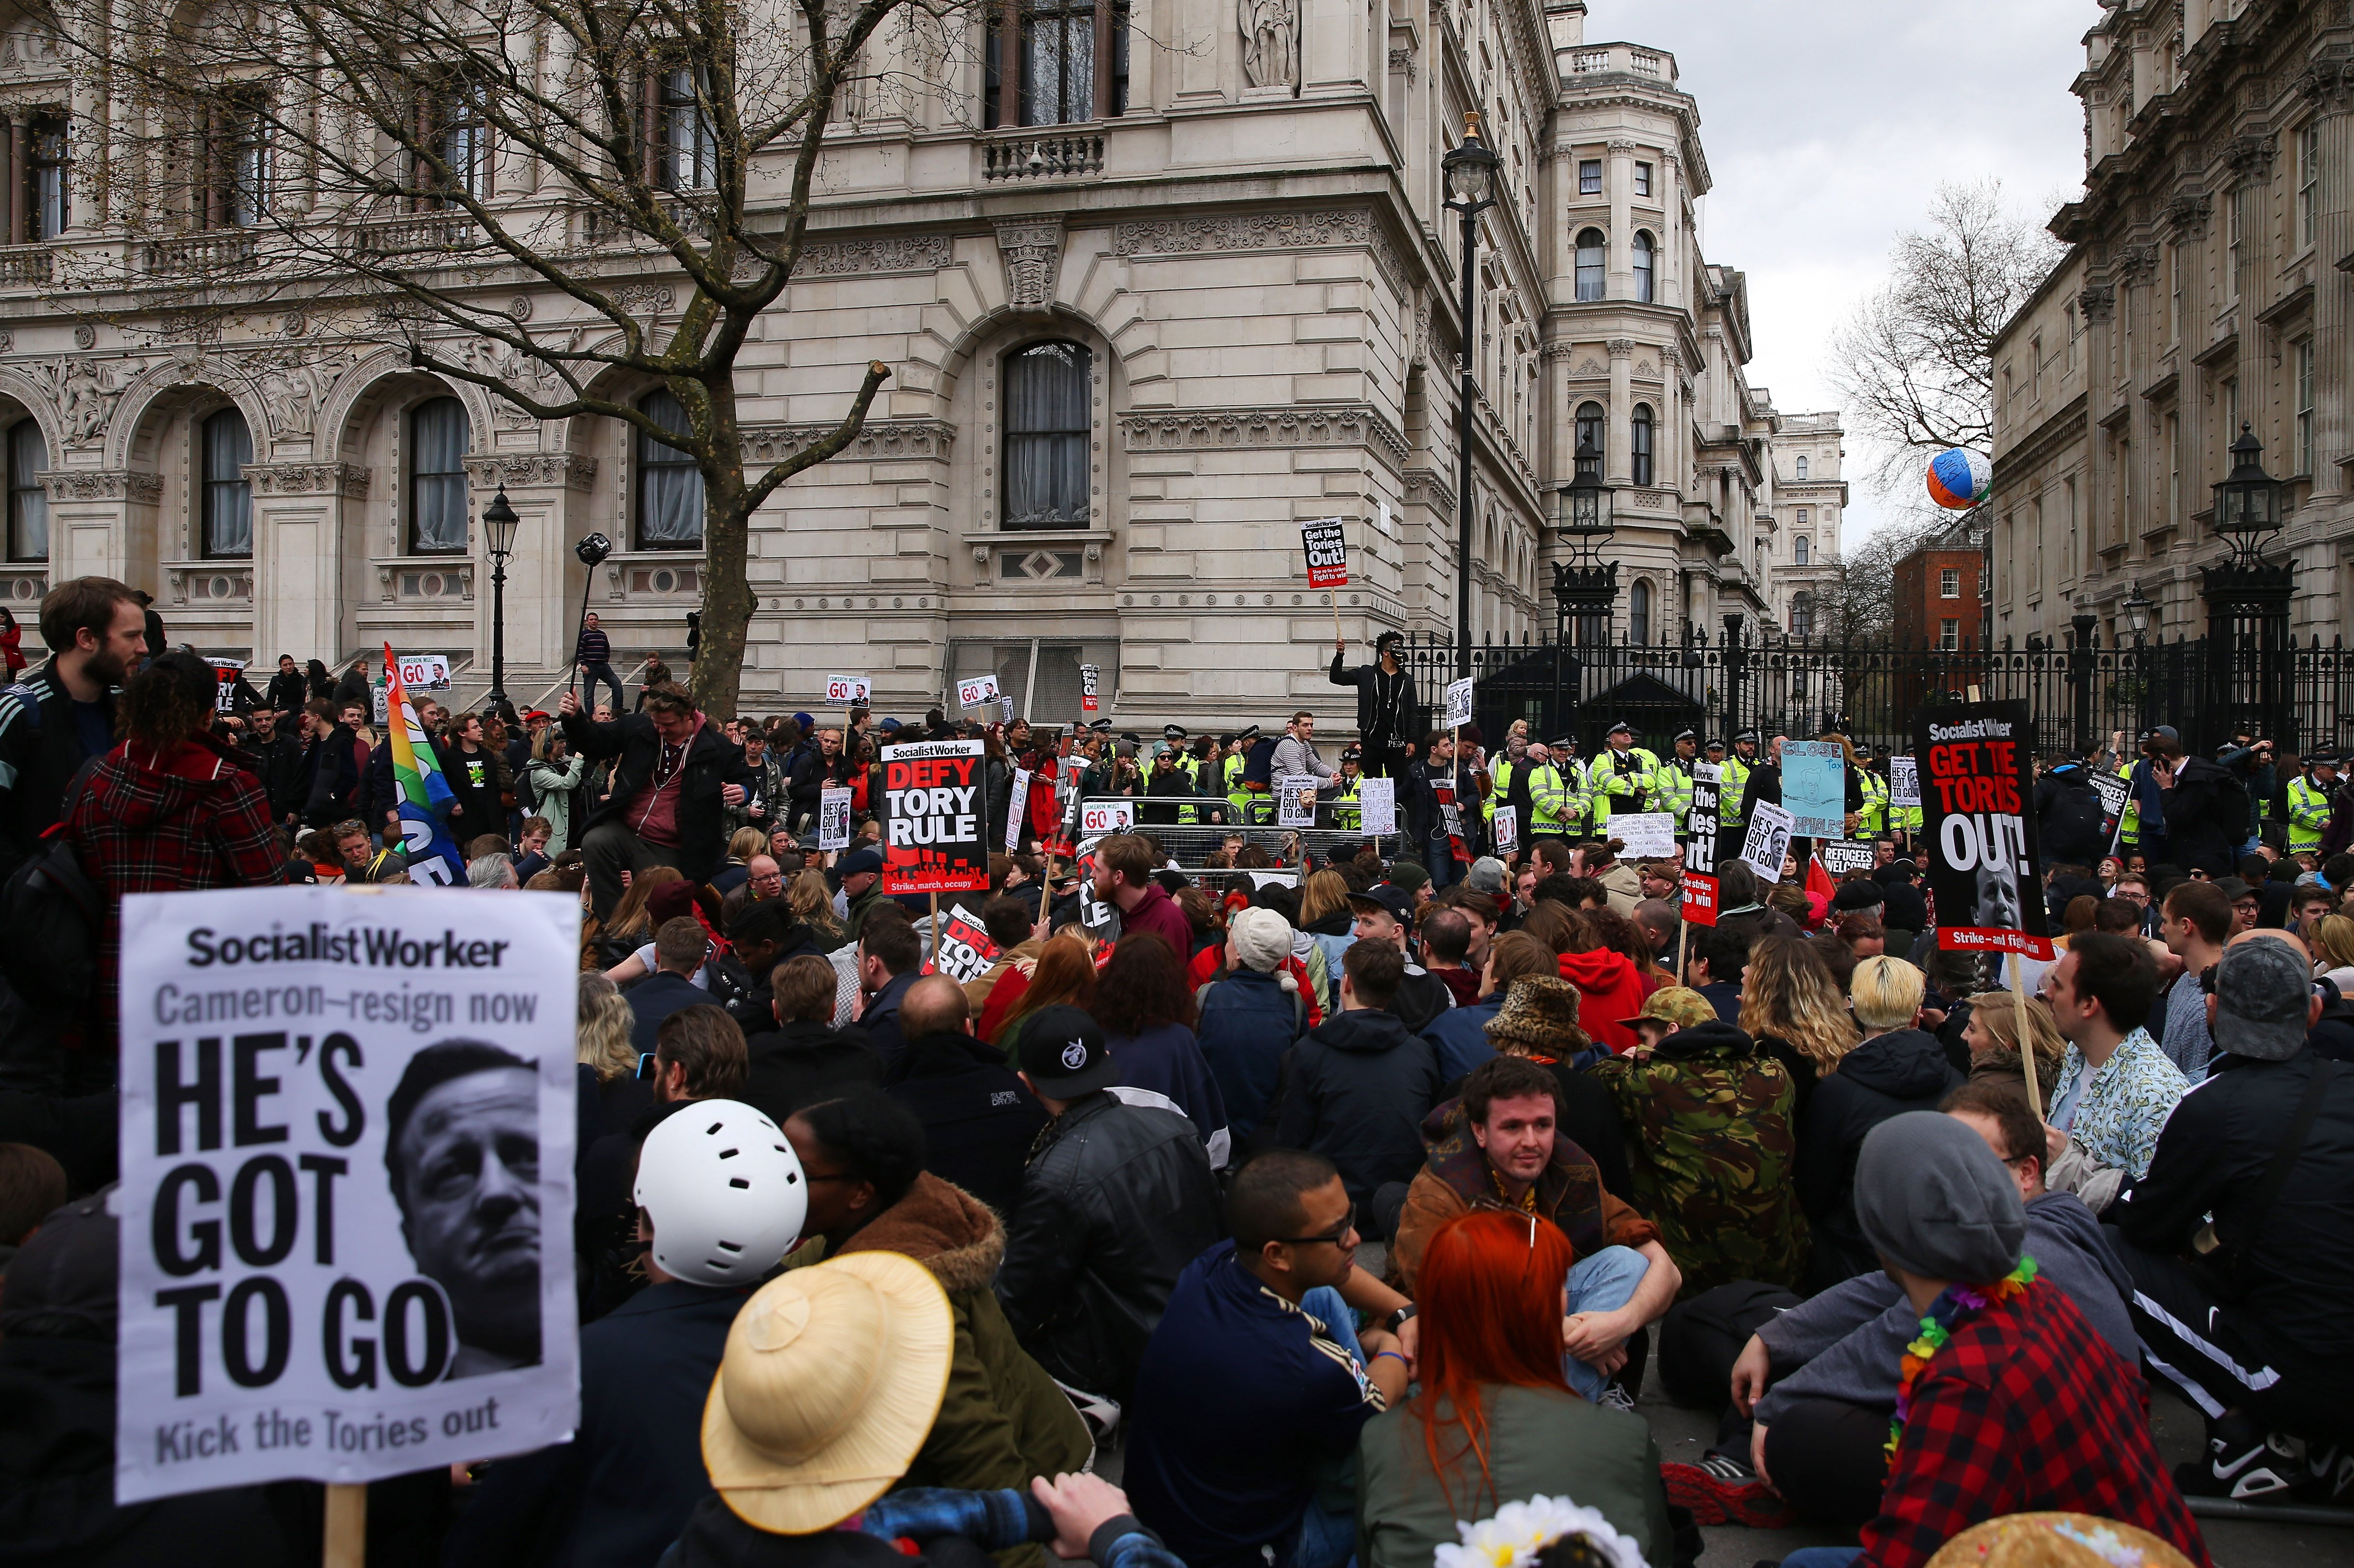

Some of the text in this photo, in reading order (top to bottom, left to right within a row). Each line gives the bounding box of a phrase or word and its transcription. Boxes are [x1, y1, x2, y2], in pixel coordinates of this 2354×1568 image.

[1306, 529, 1340, 540] Get the
[1306, 538, 1343, 551] Tories
[1309, 547, 1345, 566] Out!
[1313, 573, 1329, 582] Fight
[218, 668, 238, 682] FY
[403, 665, 424, 683] GO
[218, 682, 236, 696] RY
[829, 682, 847, 698] GO
[962, 686, 978, 702] GO
[1448, 690, 1459, 703] HE'S
[218, 697, 233, 711] LE
[1448, 700, 1458, 712] GOT
[1448, 709, 1464, 722] TO GO
[1929, 721, 1986, 741] Socialist
[893, 744, 971, 758] Socialist Worker
[1781, 741, 1841, 758] CLOSE
[1825, 759, 1842, 771] Tax
[1930, 742, 1979, 777] GET
[887, 758, 976, 790] DEFY
[1696, 768, 1713, 781] Worker
[1892, 767, 1906, 777] HE'S
[1362, 781, 1374, 790] PUT
[1374, 780, 1383, 789] ON
[1892, 777, 1905, 787] GOT
[1284, 788, 1301, 798] HE'S
[1695, 786, 1716, 808] the
[1893, 787, 1913, 797] TO GO
[824, 803, 838, 815] HE'S
[885, 786, 977, 818] TORY
[1283, 798, 1299, 808] GOT
[1373, 799, 1381, 807] UP
[1283, 808, 1306, 818] TO GO
[1362, 814, 1393, 824] PAY YOUR
[1760, 803, 1789, 820] Socialist Worker
[823, 816, 837, 828] GOT
[1085, 810, 1107, 829] GO
[1689, 807, 1716, 835] ies
[1752, 814, 1772, 835] HE'S
[823, 827, 840, 840] TO GO
[888, 814, 977, 845] RULE
[1362, 824, 1383, 832] TAXES
[1497, 818, 1507, 842] GO
[1748, 829, 1767, 848] GOT
[1940, 813, 2030, 876] OUT!
[1687, 835, 1715, 873] ut!
[1745, 843, 1772, 868] TO GO
[1825, 847, 1873, 863] REFUGEES
[891, 880, 972, 891] Strike, march, occupy
[1692, 880, 1712, 891] strikes
[1685, 890, 1711, 908] to win
[1081, 902, 1111, 927] LE
[187, 923, 510, 968] Socialist Worker
[2027, 941, 2039, 954] win
[940, 933, 995, 976] TOR
[1096, 956, 1109, 966] cupy
[469, 992, 537, 1023] now
[154, 1031, 367, 1157] HE'S
[991, 1091, 1016, 1099] SUPER
[151, 1154, 349, 1278] GOT
[154, 1275, 452, 1398] TO GO
[155, 1397, 501, 1466] Kick the Tories out
